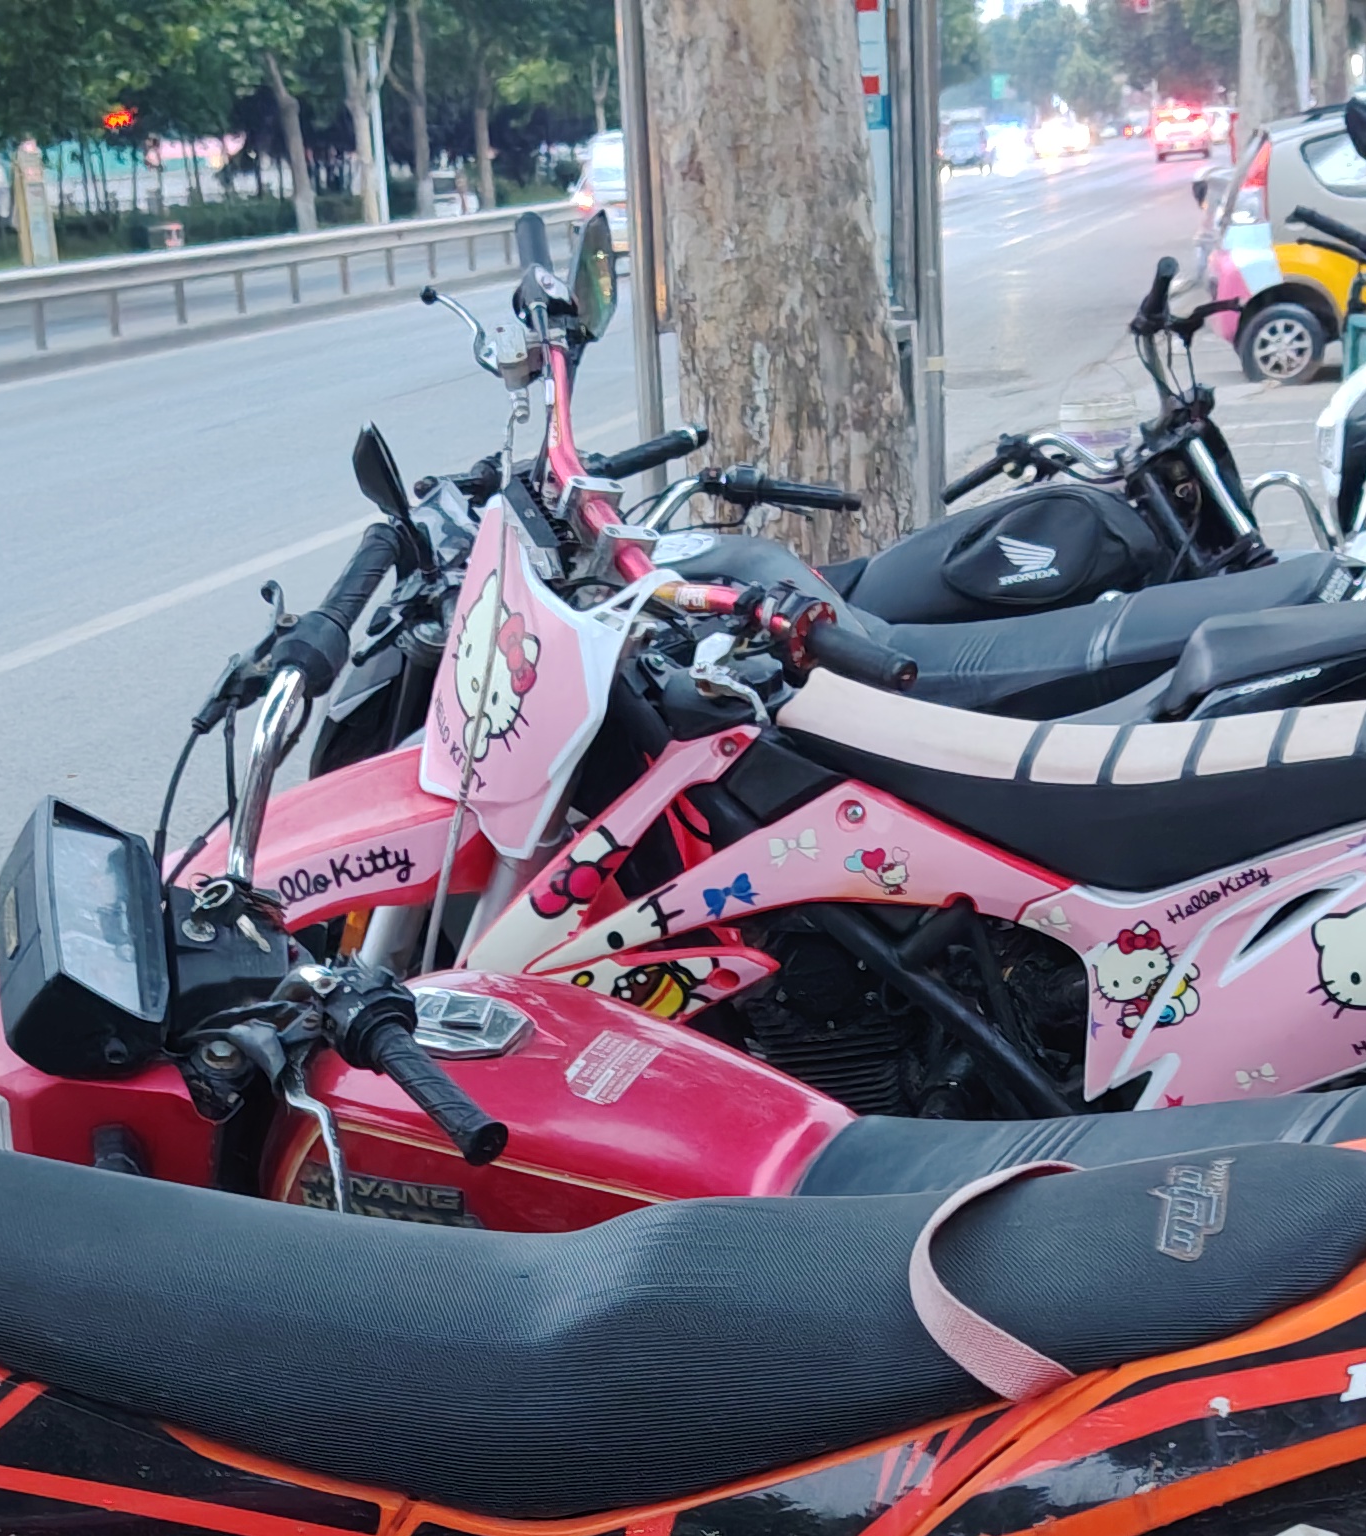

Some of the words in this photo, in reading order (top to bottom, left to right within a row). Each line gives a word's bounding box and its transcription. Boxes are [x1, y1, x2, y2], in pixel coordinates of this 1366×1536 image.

[998, 567, 1061, 586] HONDA
[279, 866, 330, 902] llo
[330, 847, 415, 886] Kitty
[1167, 890, 1221, 924] Hello
[1218, 866, 1272, 901] Kitty
